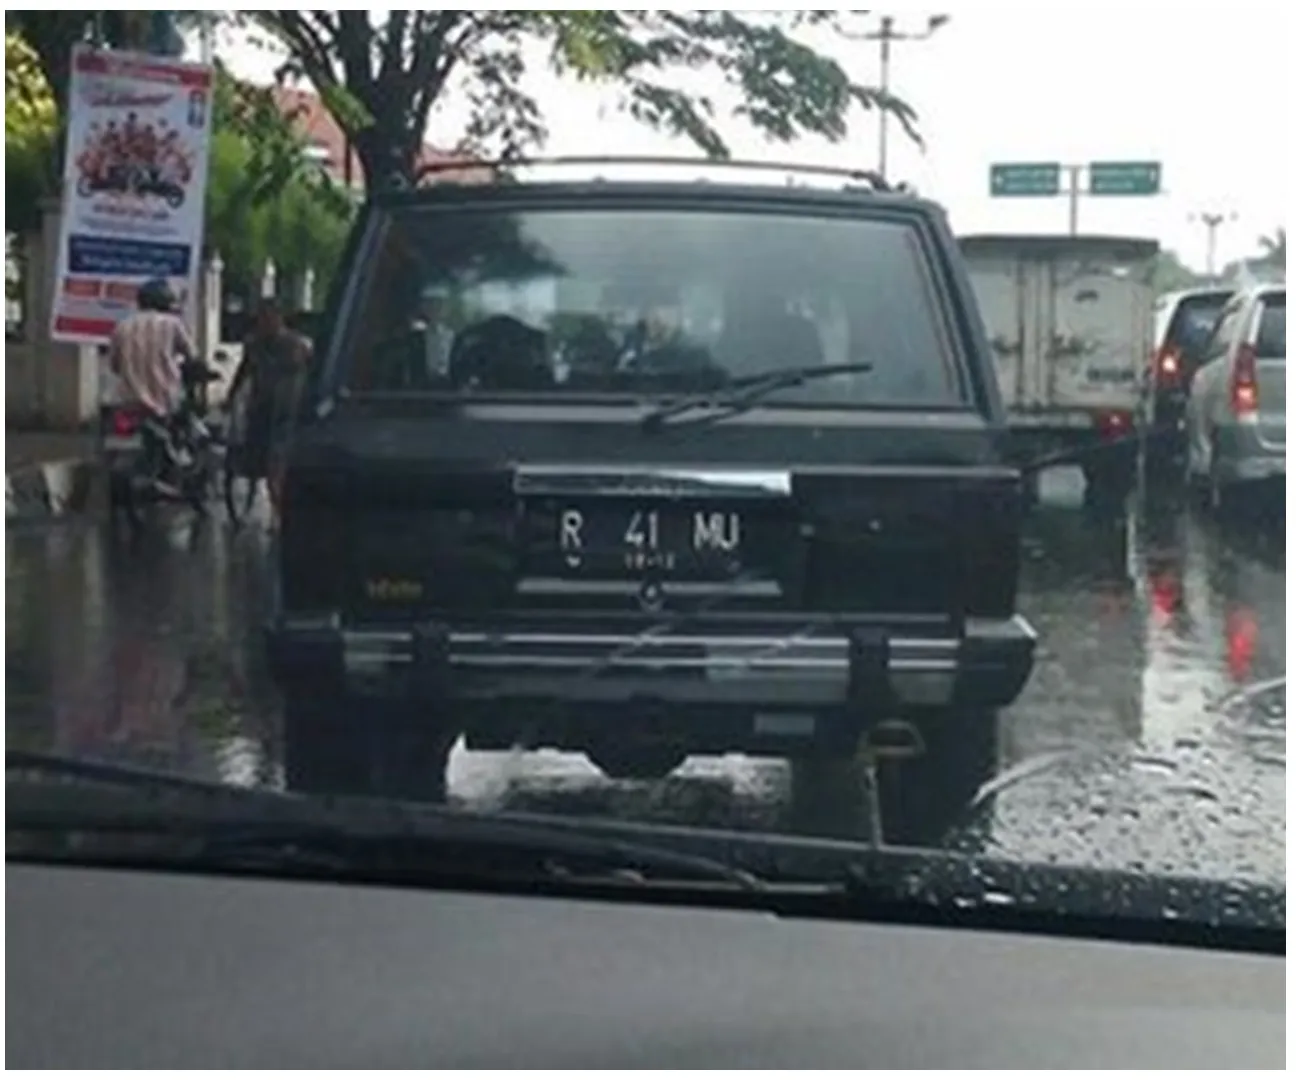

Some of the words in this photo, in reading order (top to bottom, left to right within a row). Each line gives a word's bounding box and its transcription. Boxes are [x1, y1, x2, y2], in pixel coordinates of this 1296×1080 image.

[560, 509, 584, 549] R
[623, 510, 659, 550] 41
[693, 511, 740, 550] MU
